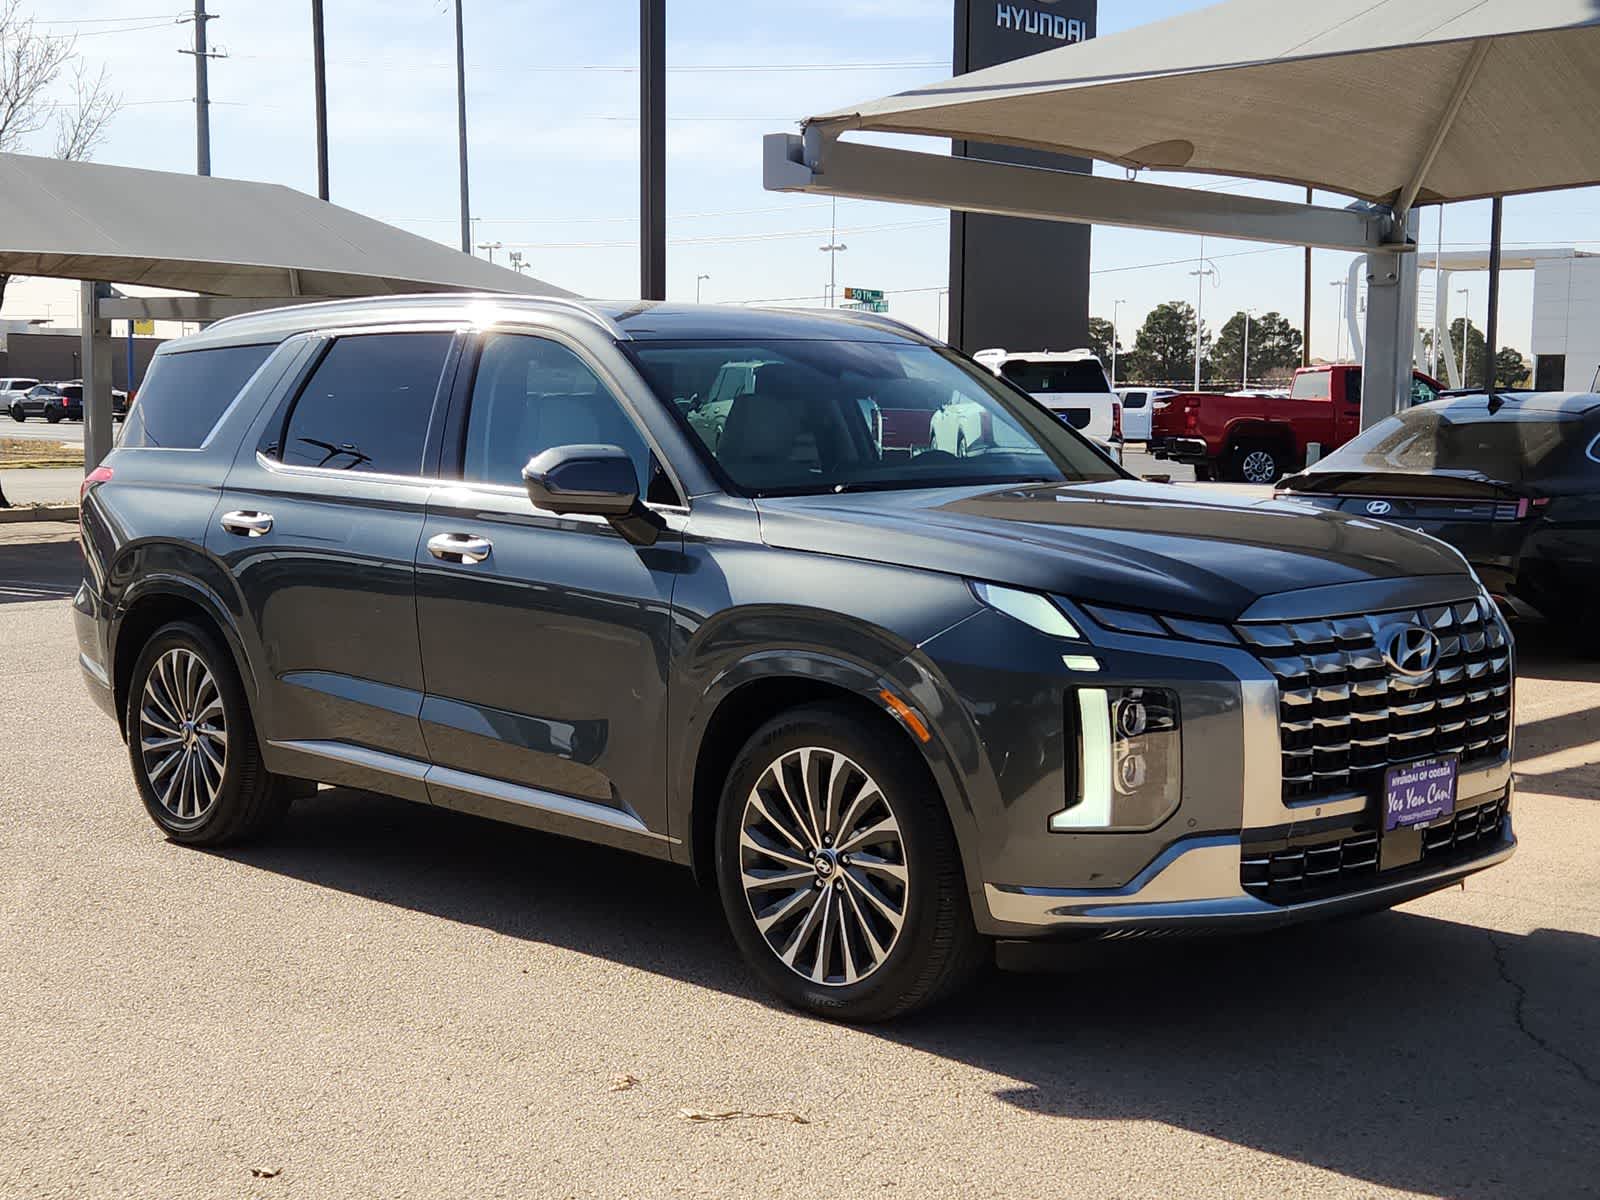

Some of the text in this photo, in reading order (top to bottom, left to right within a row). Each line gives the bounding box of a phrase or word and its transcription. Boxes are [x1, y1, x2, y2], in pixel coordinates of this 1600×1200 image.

[996, 3, 1087, 42] HYUNDAI
[1419, 771, 1427, 780] OF
[1388, 778, 1453, 813] Yes You Can!
